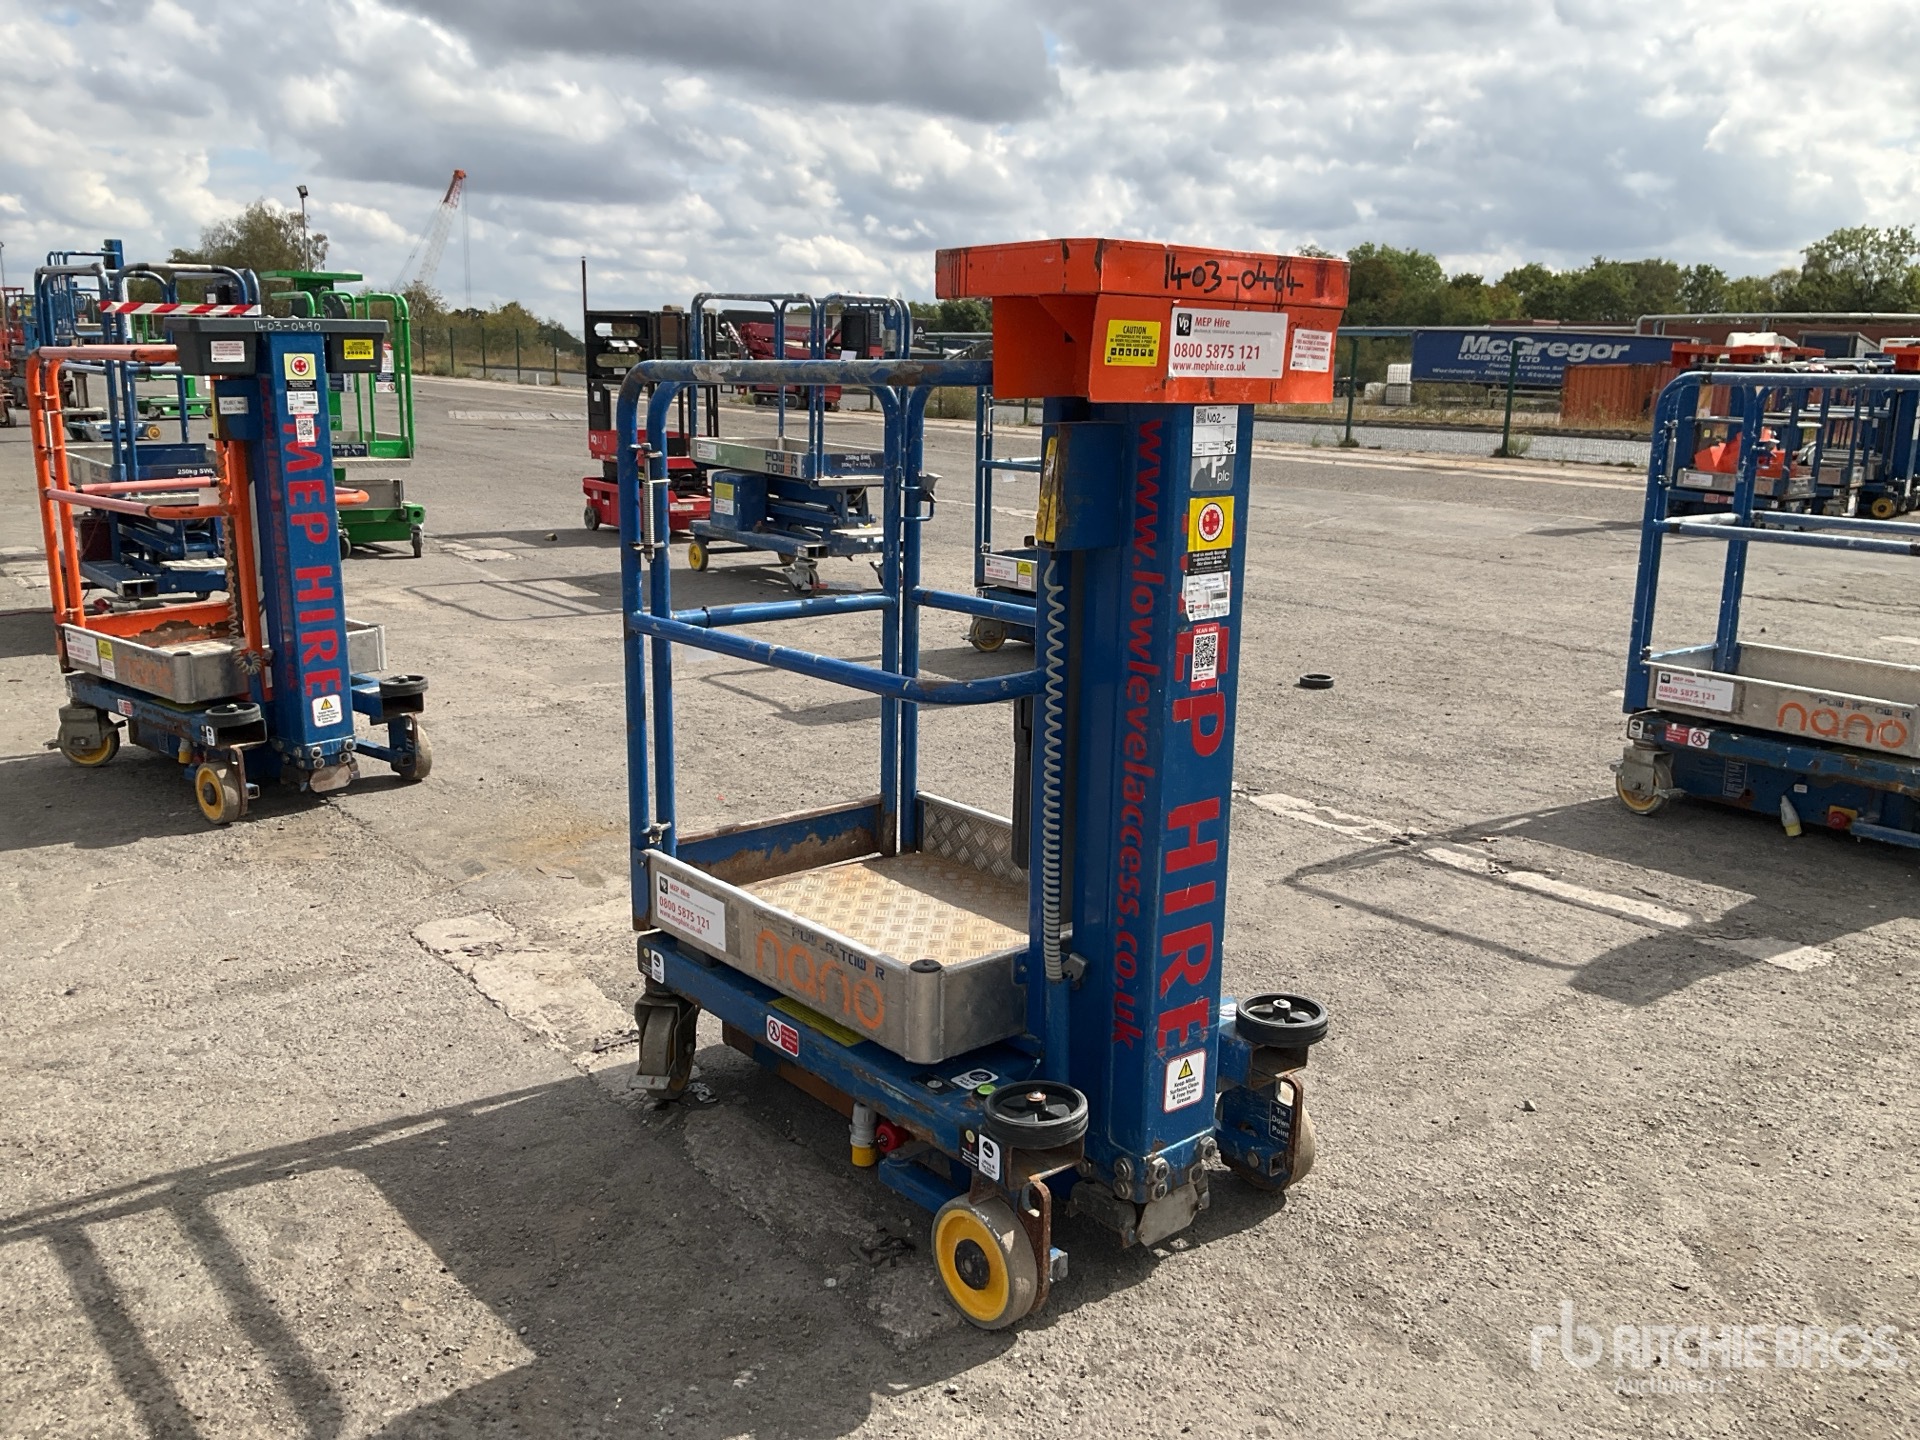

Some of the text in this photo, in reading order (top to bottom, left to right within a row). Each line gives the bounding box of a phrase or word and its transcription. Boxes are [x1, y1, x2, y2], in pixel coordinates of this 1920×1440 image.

[254, 321, 320, 332] 1403-0490
[1123, 326, 1147, 334] CAUTION
[1194, 317, 1230, 328] MEP Hire
[1174, 343, 1260, 360] 0800 5875 121
[1460, 335, 1631, 363] McGregor
[1172, 361, 1246, 373] www.mephire.co.uk
[765, 450, 798, 465] POWER
[177, 468, 198, 476] 250kg
[765, 462, 798, 476] TOWER
[283, 422, 331, 544] MEP
[1217, 470, 1230, 484] plc
[295, 565, 342, 697] HIRE
[1659, 685, 1715, 701] 0800 5875 121
[1777, 702, 1907, 748] nano
[1111, 419, 1164, 1049] www.lowlevelaccess.co.uk
[669, 883, 691, 899] MEP Hire
[659, 896, 676, 912] 0800
[678, 905, 695, 922] 5875
[696, 915, 710, 930] 121
[1157, 797, 1219, 1058] HIRE
[756, 929, 885, 1030] nano
[1276, 1106, 1287, 1117] Tie
[1271, 1114, 1290, 1128] Down
[1272, 1125, 1290, 1138] Point
